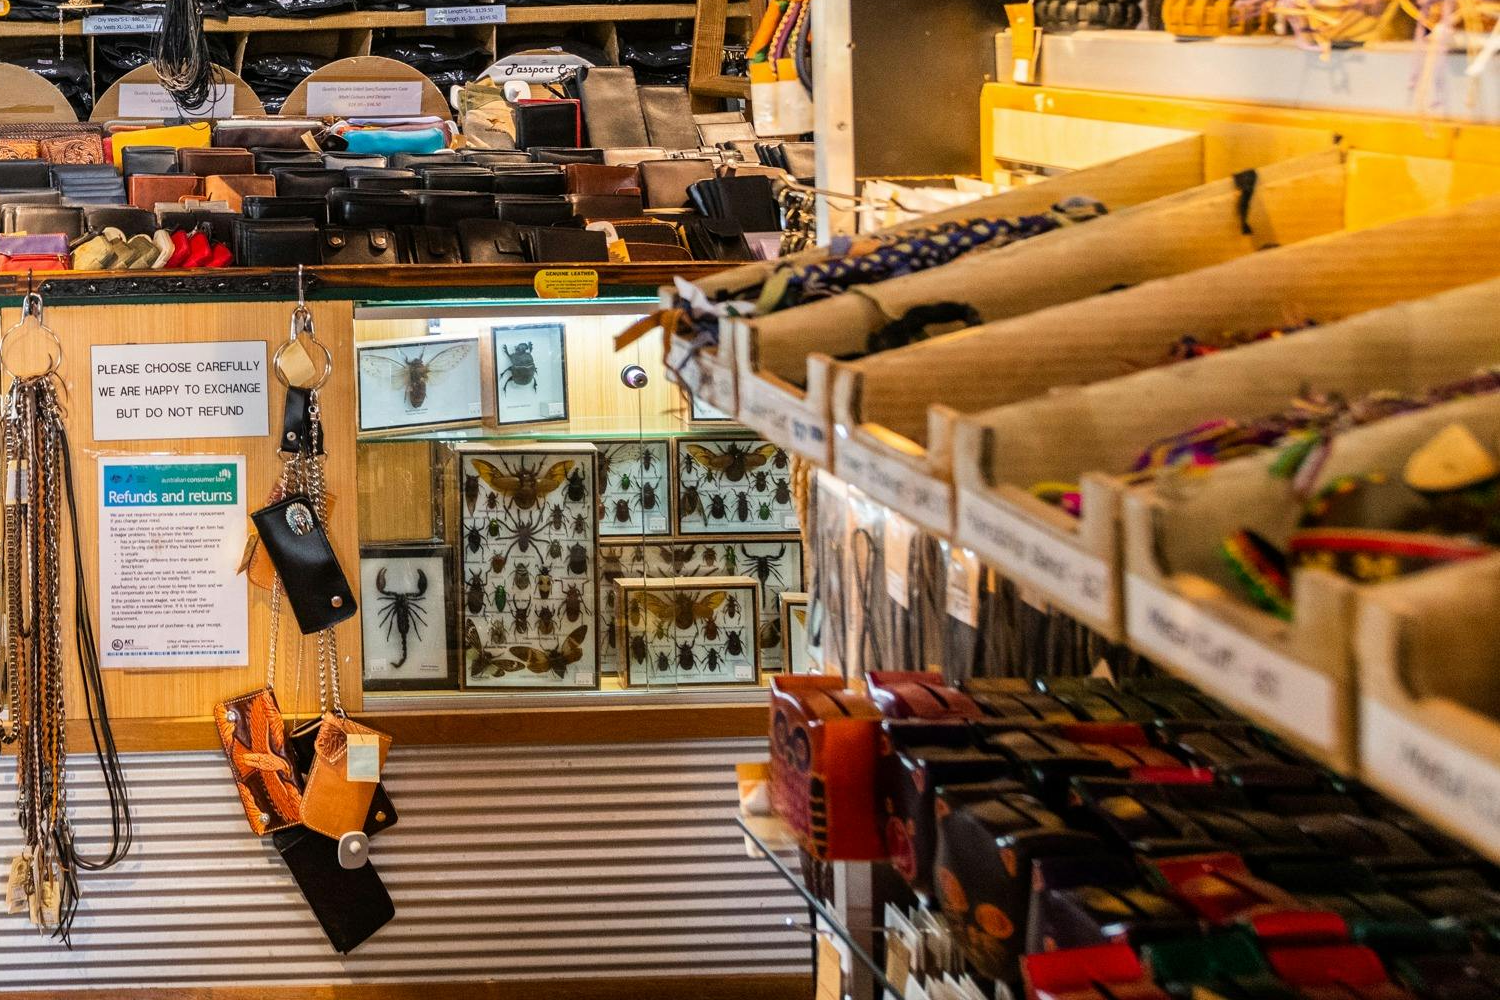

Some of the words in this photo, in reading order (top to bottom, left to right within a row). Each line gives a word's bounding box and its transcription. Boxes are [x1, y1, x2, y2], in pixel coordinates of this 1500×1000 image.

[505, 64, 554, 77] Passport
[98, 364, 139, 374] PLEASE
[145, 363, 191, 373] CHOOSE
[197, 361, 260, 372] CAREFULLY
[99, 386, 115, 397] WE
[120, 386, 140, 396] ARE
[145, 385, 180, 396] HAPPY
[185, 384, 200, 395] TO
[204, 383, 261, 394] EXCHANGE
[116, 408, 140, 419] BUT
[146, 408, 163, 418] DO
[168, 407, 193, 417] NOT
[199, 406, 244, 416] REFUND
[108, 490, 157, 503] Refunds
[162, 490, 184, 502] and
[189, 491, 232, 502] returns
